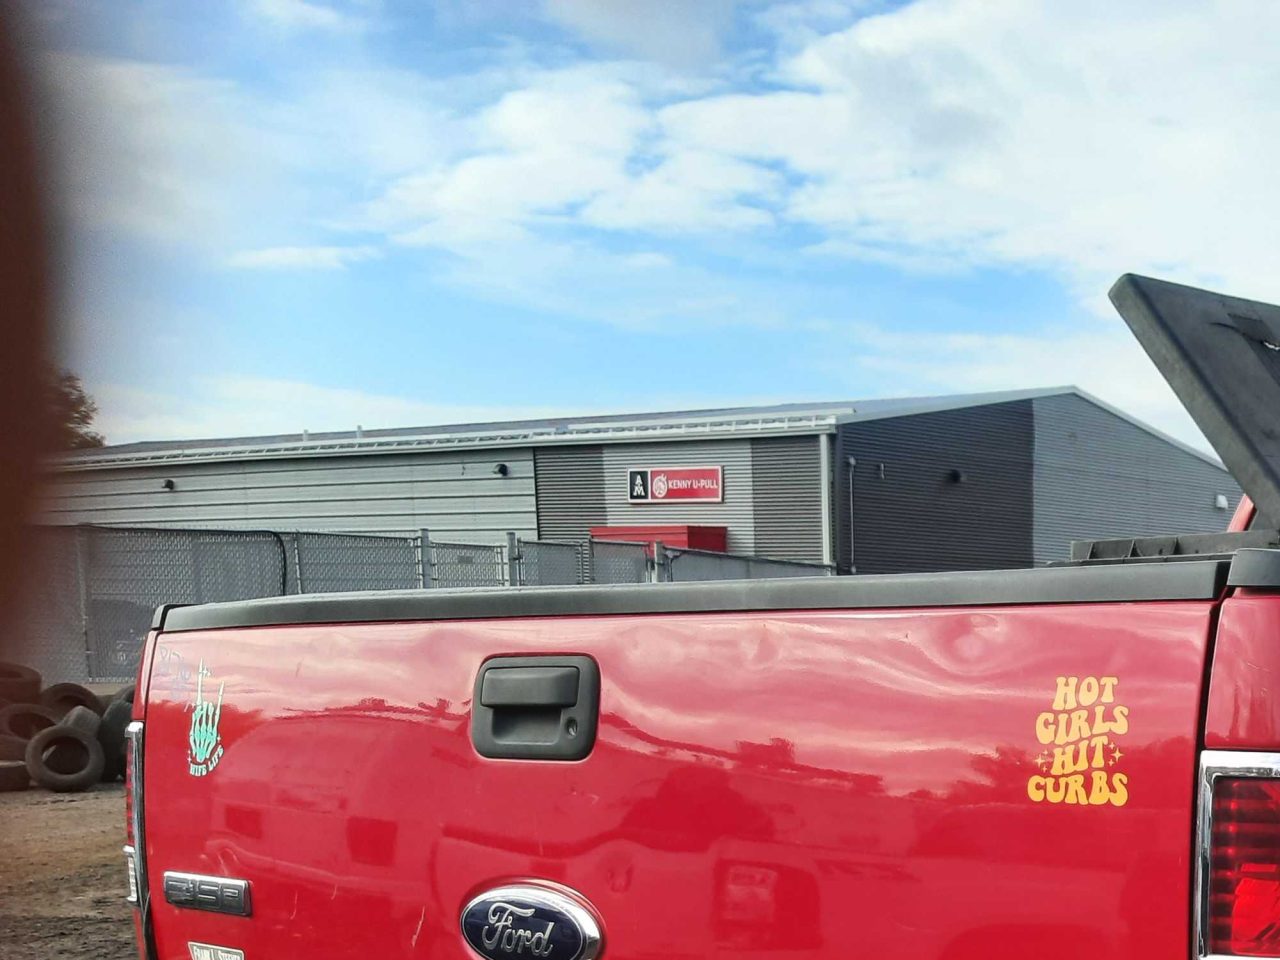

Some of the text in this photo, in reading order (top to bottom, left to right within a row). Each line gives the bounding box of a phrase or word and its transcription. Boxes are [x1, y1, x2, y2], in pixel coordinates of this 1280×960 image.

[668, 479, 718, 489] KENNY U-PULL
[1052, 676, 1119, 711] HOT
[1035, 705, 1129, 745] GIRLS
[1050, 735, 1109, 776] HIT
[1027, 770, 1129, 807] CURBS
[481, 902, 555, 958] Ford
